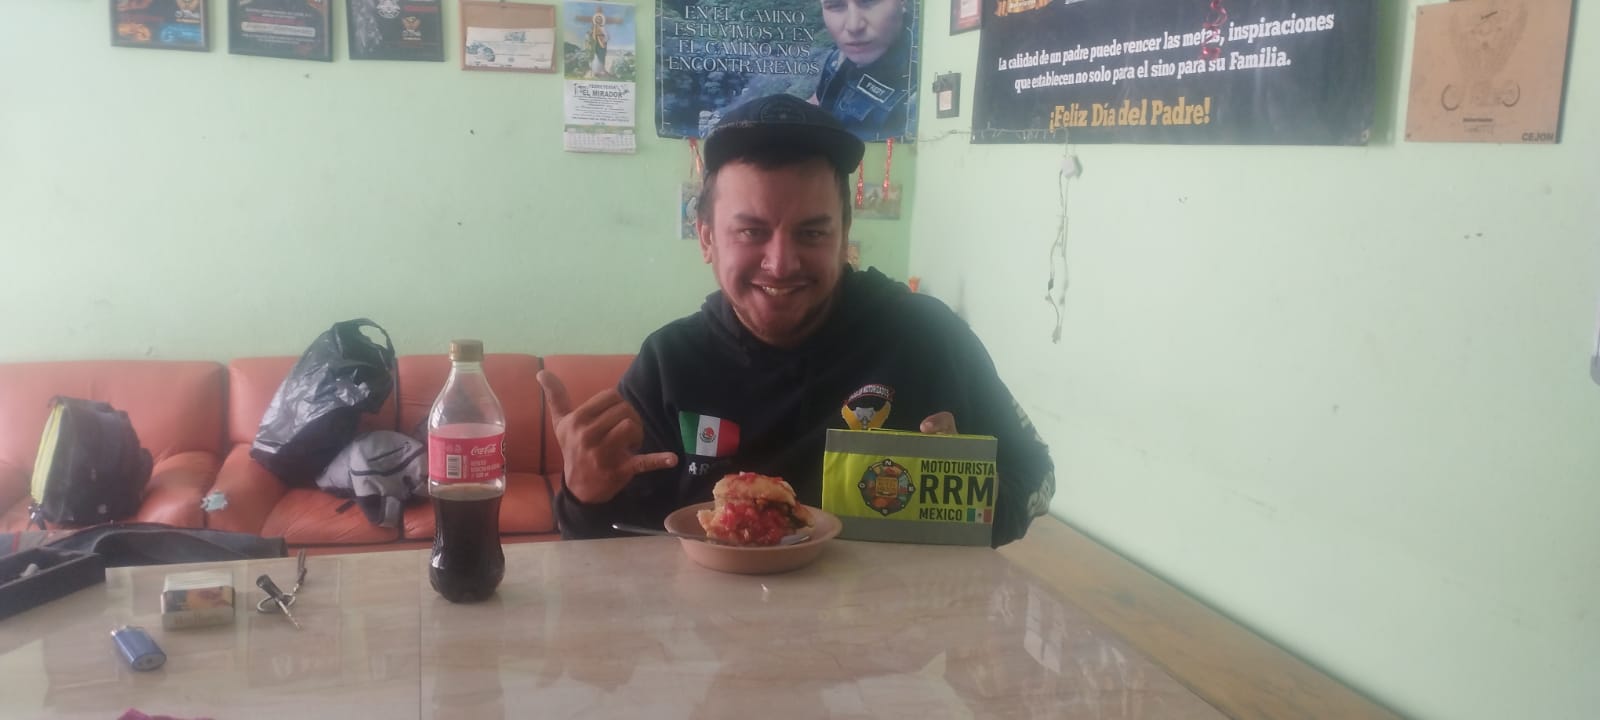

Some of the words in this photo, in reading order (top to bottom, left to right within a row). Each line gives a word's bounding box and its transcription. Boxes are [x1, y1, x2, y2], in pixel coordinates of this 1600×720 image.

[685, 5, 708, 20] EN
[713, 6, 733, 21] EL
[740, 9, 805, 23] CAMINO
[675, 22, 772, 39] ESTUVIMOS
[777, 26, 788, 40] Y
[793, 28, 815, 41] EN
[679, 40, 700, 53] EL
[705, 40, 772, 56] CAMINO
[777, 43, 810, 57] NOS
[998, 58, 1007, 71] La
[1008, 51, 1038, 69] calidad
[1039, 50, 1049, 65] de
[1050, 52, 1061, 64] un
[1062, 45, 1088, 66] padre
[1090, 39, 1122, 62] puede
[1123, 36, 1162, 53] vencer
[1163, 31, 1180, 49] las
[1182, 27, 1225, 47] metas,
[1228, 13, 1335, 43] inspiraciones
[669, 56, 820, 74] ENCONTRAREMOS
[1014, 78, 1031, 94] que
[1032, 70, 1074, 88] establecen
[1075, 73, 1088, 84] no
[1089, 65, 1111, 82] solo
[1112, 64, 1135, 85] para
[1136, 60, 1149, 78] el
[1151, 59, 1176, 77] sino
[1177, 60, 1206, 79] para
[1208, 57, 1226, 71] su
[1228, 46, 1292, 71] Familia.
[1050, 103, 1088, 133] ¡Feliz
[1091, 102, 1115, 127] Día
[1118, 98, 1147, 127] del
[1151, 96, 1211, 126] Padre!
[920, 460, 995, 476] MOTOTURISTA
[920, 474, 994, 507] RRM
[920, 508, 963, 522] MEXICO
